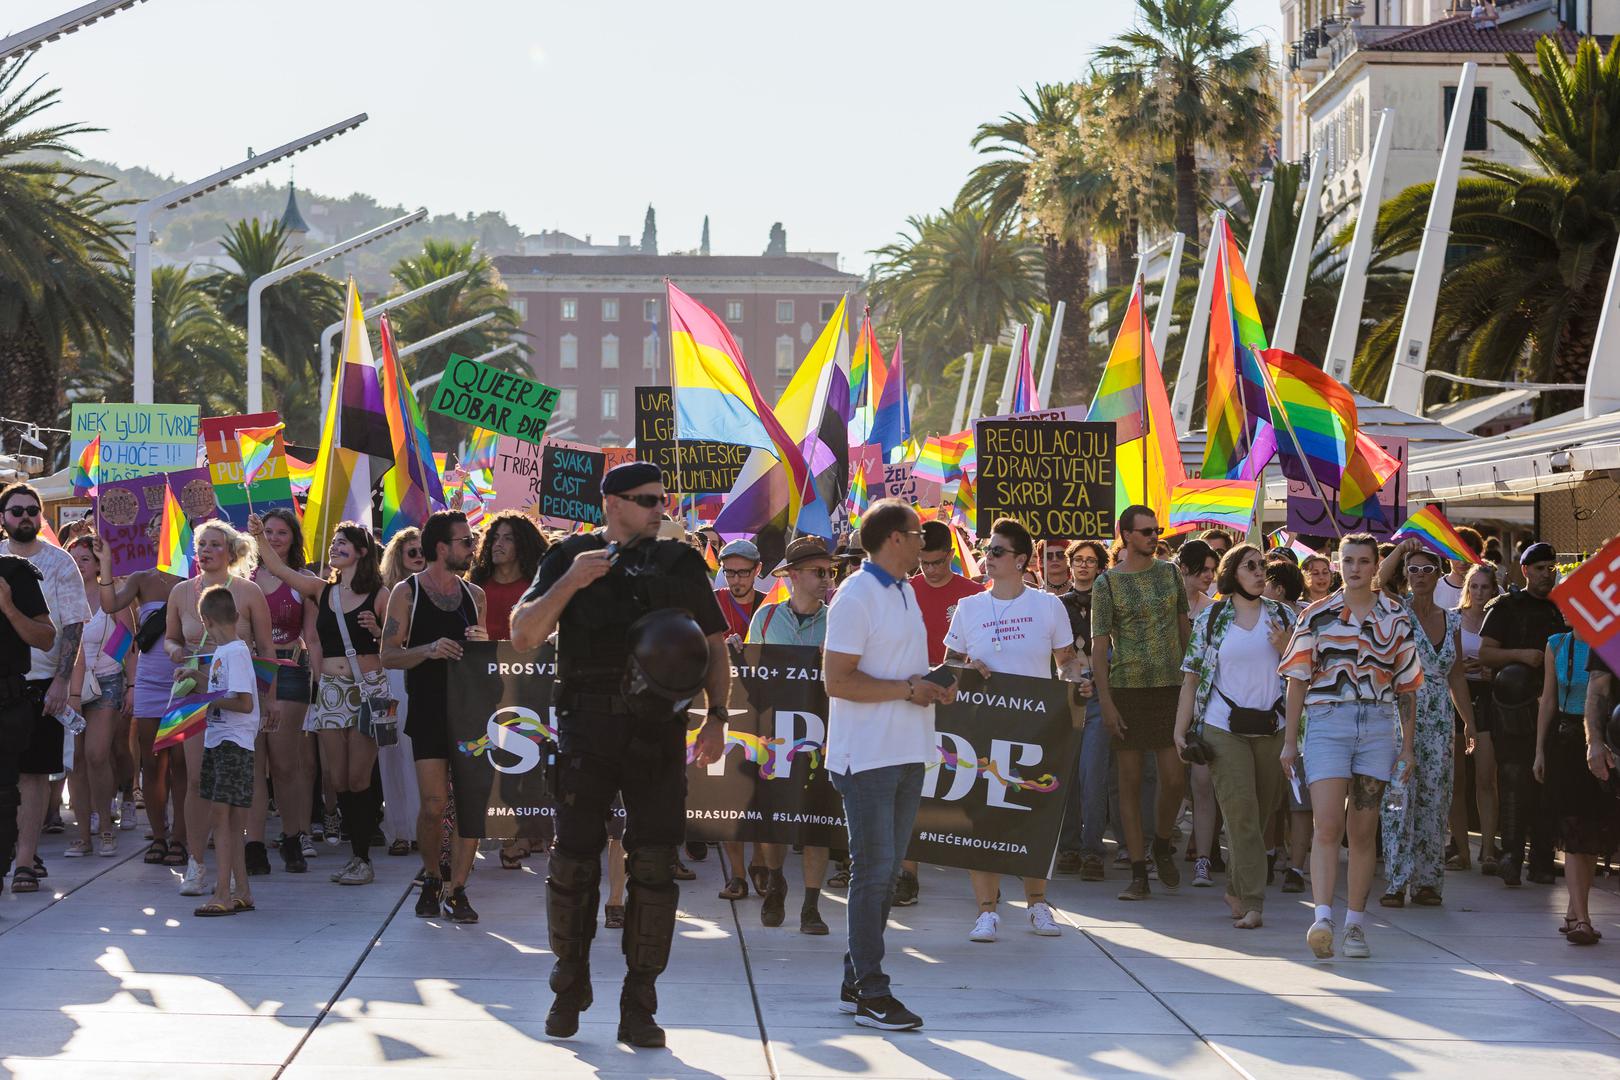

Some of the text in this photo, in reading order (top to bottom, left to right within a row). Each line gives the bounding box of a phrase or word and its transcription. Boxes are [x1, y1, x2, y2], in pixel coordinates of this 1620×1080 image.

[452, 358, 558, 414] QUEER JE
[640, 392, 674, 412] UVR
[157, 412, 199, 437] TVRDE
[438, 388, 548, 442] DOBAR ĐIR
[117, 441, 159, 467] HOĆE
[660, 441, 748, 465] STRATEŠKE
[984, 428, 1109, 458] REGULACIJU
[499, 453, 539, 477] TRIBA
[553, 451, 593, 476] SVAKA
[982, 455, 1112, 486] ZDRAVSTVENE
[553, 472, 587, 496] ČAST
[662, 469, 741, 490] OKUMENTE
[996, 482, 1090, 507] SKRBI ZA
[543, 495, 603, 524] PEDERIMA
[1046, 510, 1113, 538] OSOBE
[111, 542, 155, 565] TRAN
[487, 662, 555, 676] PROSVJ
[729, 665, 779, 680] BTIQ+
[956, 690, 1047, 713] MOVANKA
[686, 809, 763, 821] DRASUDAMA
[772, 812, 849, 827] #SLAVIMORAZ
[919, 831, 1028, 854] #NEĆEMOU4ZIDA
